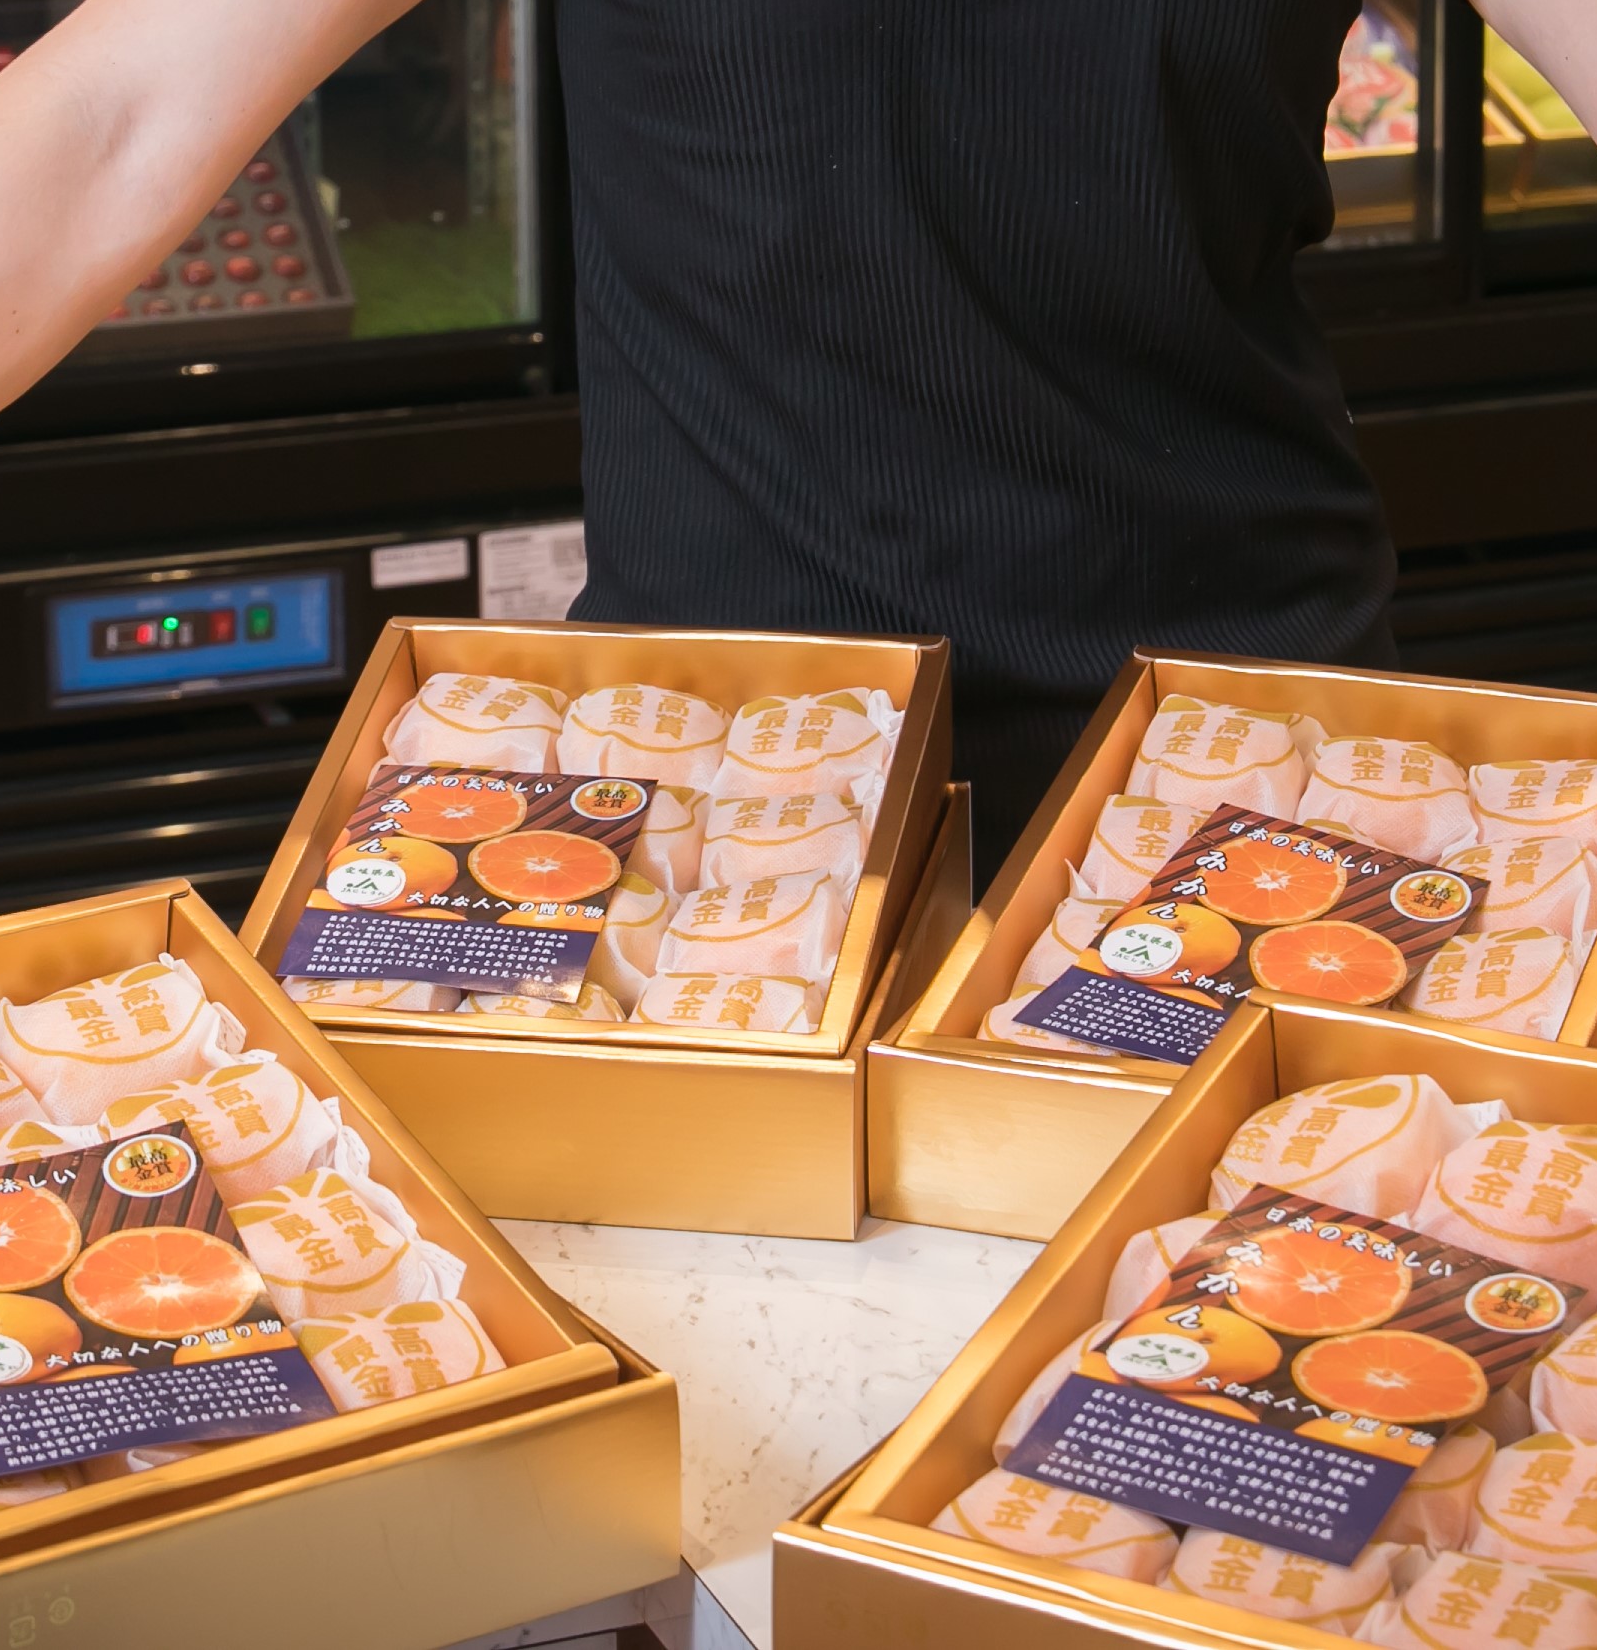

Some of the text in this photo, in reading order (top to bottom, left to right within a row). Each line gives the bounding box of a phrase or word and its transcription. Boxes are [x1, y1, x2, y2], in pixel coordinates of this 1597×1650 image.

[396, 774, 554, 793] 日本の美味しい
[359, 799, 412, 852] みかん
[1227, 821, 1383, 875] 日本の美味しい
[407, 891, 603, 918] 大切な人への贈り物
[1152, 850, 1230, 918] みかん
[1261, 1207, 1456, 1277] 日本の美味しい
[1169, 1240, 1268, 1328] みかん
[44, 1318, 283, 1368] 大切な人への贈り物
